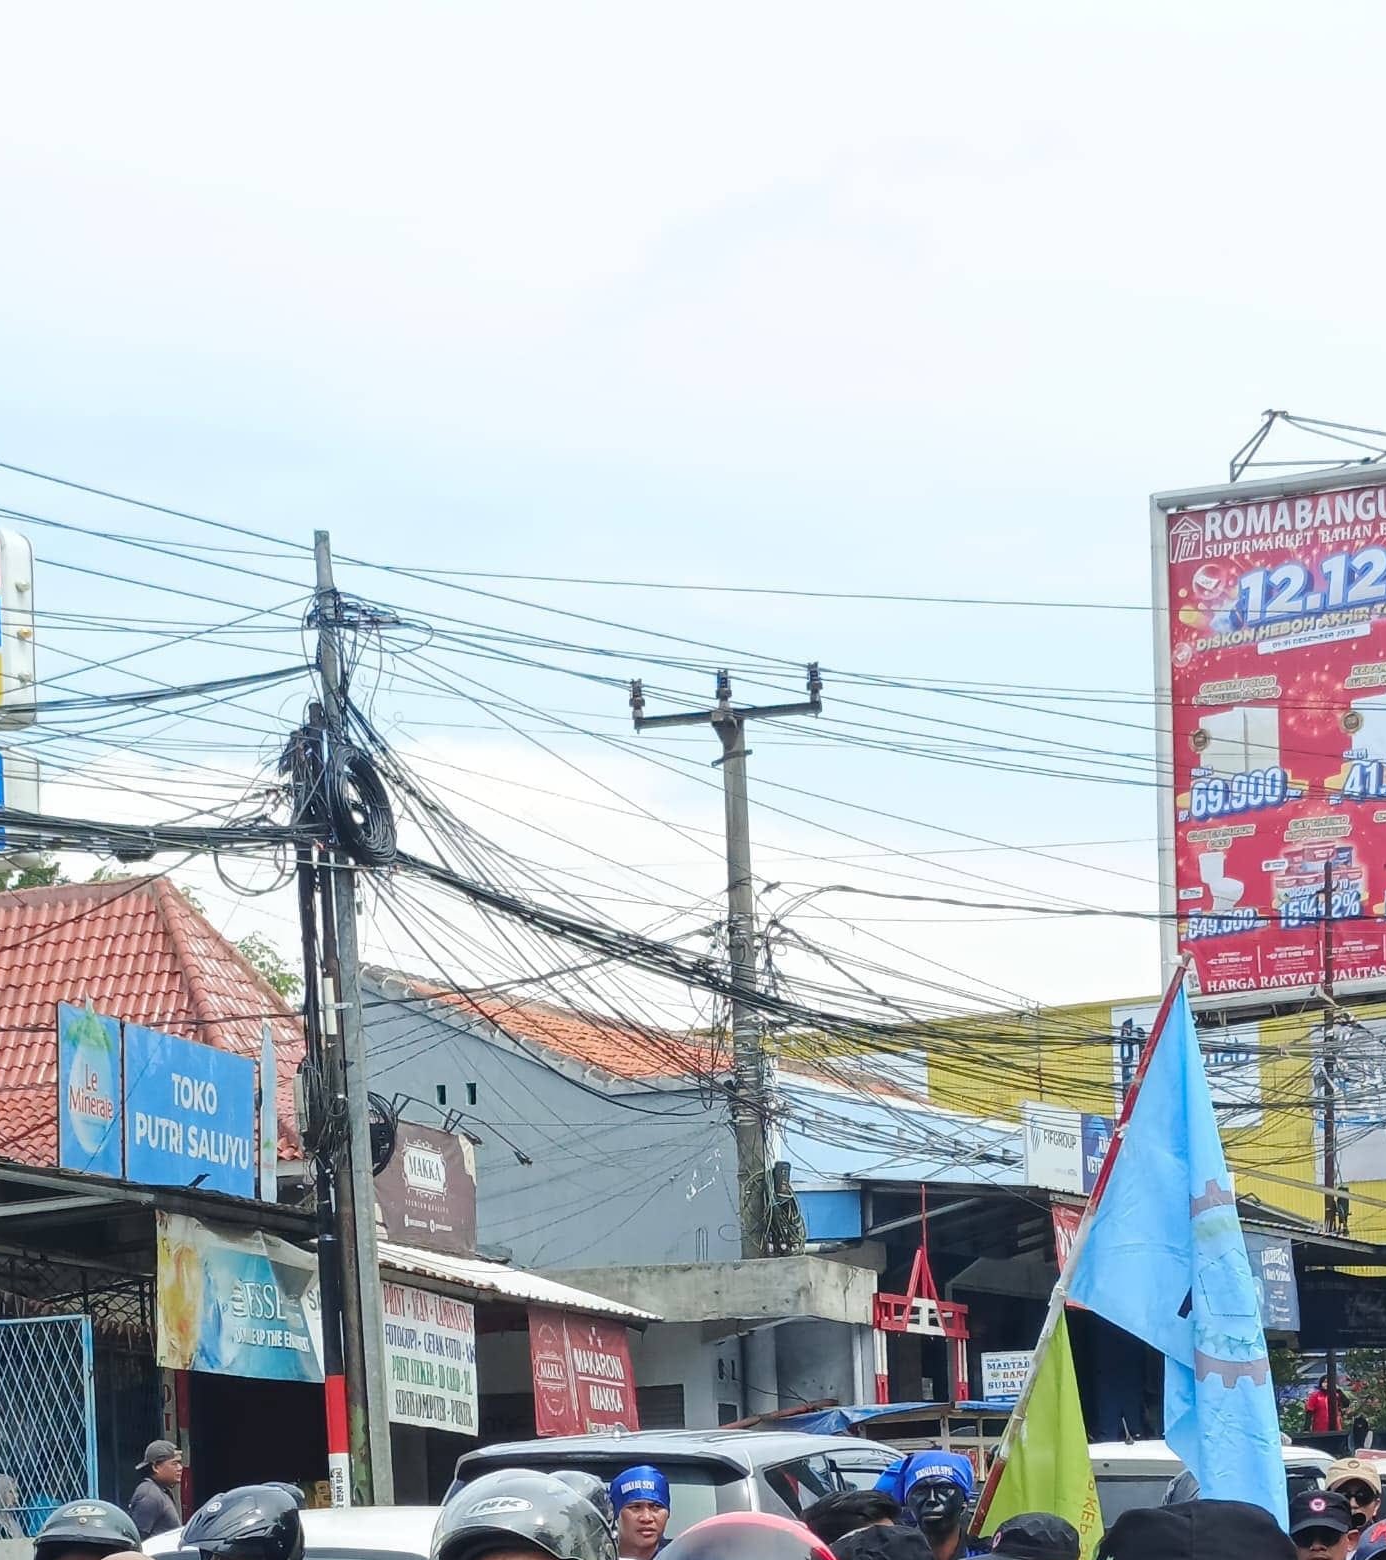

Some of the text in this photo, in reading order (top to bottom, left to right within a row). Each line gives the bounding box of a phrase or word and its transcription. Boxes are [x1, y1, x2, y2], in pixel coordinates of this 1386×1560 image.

[1204, 529, 1313, 559] SUPERMARKET
[1320, 523, 1373, 542] BAHAN
[1196, 631, 1255, 652] DISKON
[1256, 618, 1316, 641] HEBOH
[1191, 767, 1286, 818] 69.900
[1207, 977, 1256, 993] HARGA
[1260, 971, 1314, 989] RAKYAT
[84, 1068, 99, 1094] Le
[171, 1072, 218, 1115] TOKO
[135, 1112, 249, 1171] PUTRI SALUYU
[408, 1154, 442, 1182] MAKKA
[383, 1285, 406, 1318] PRINT
[573, 1347, 625, 1380] MAKARONI
[589, 1384, 624, 1413] MAKKA
